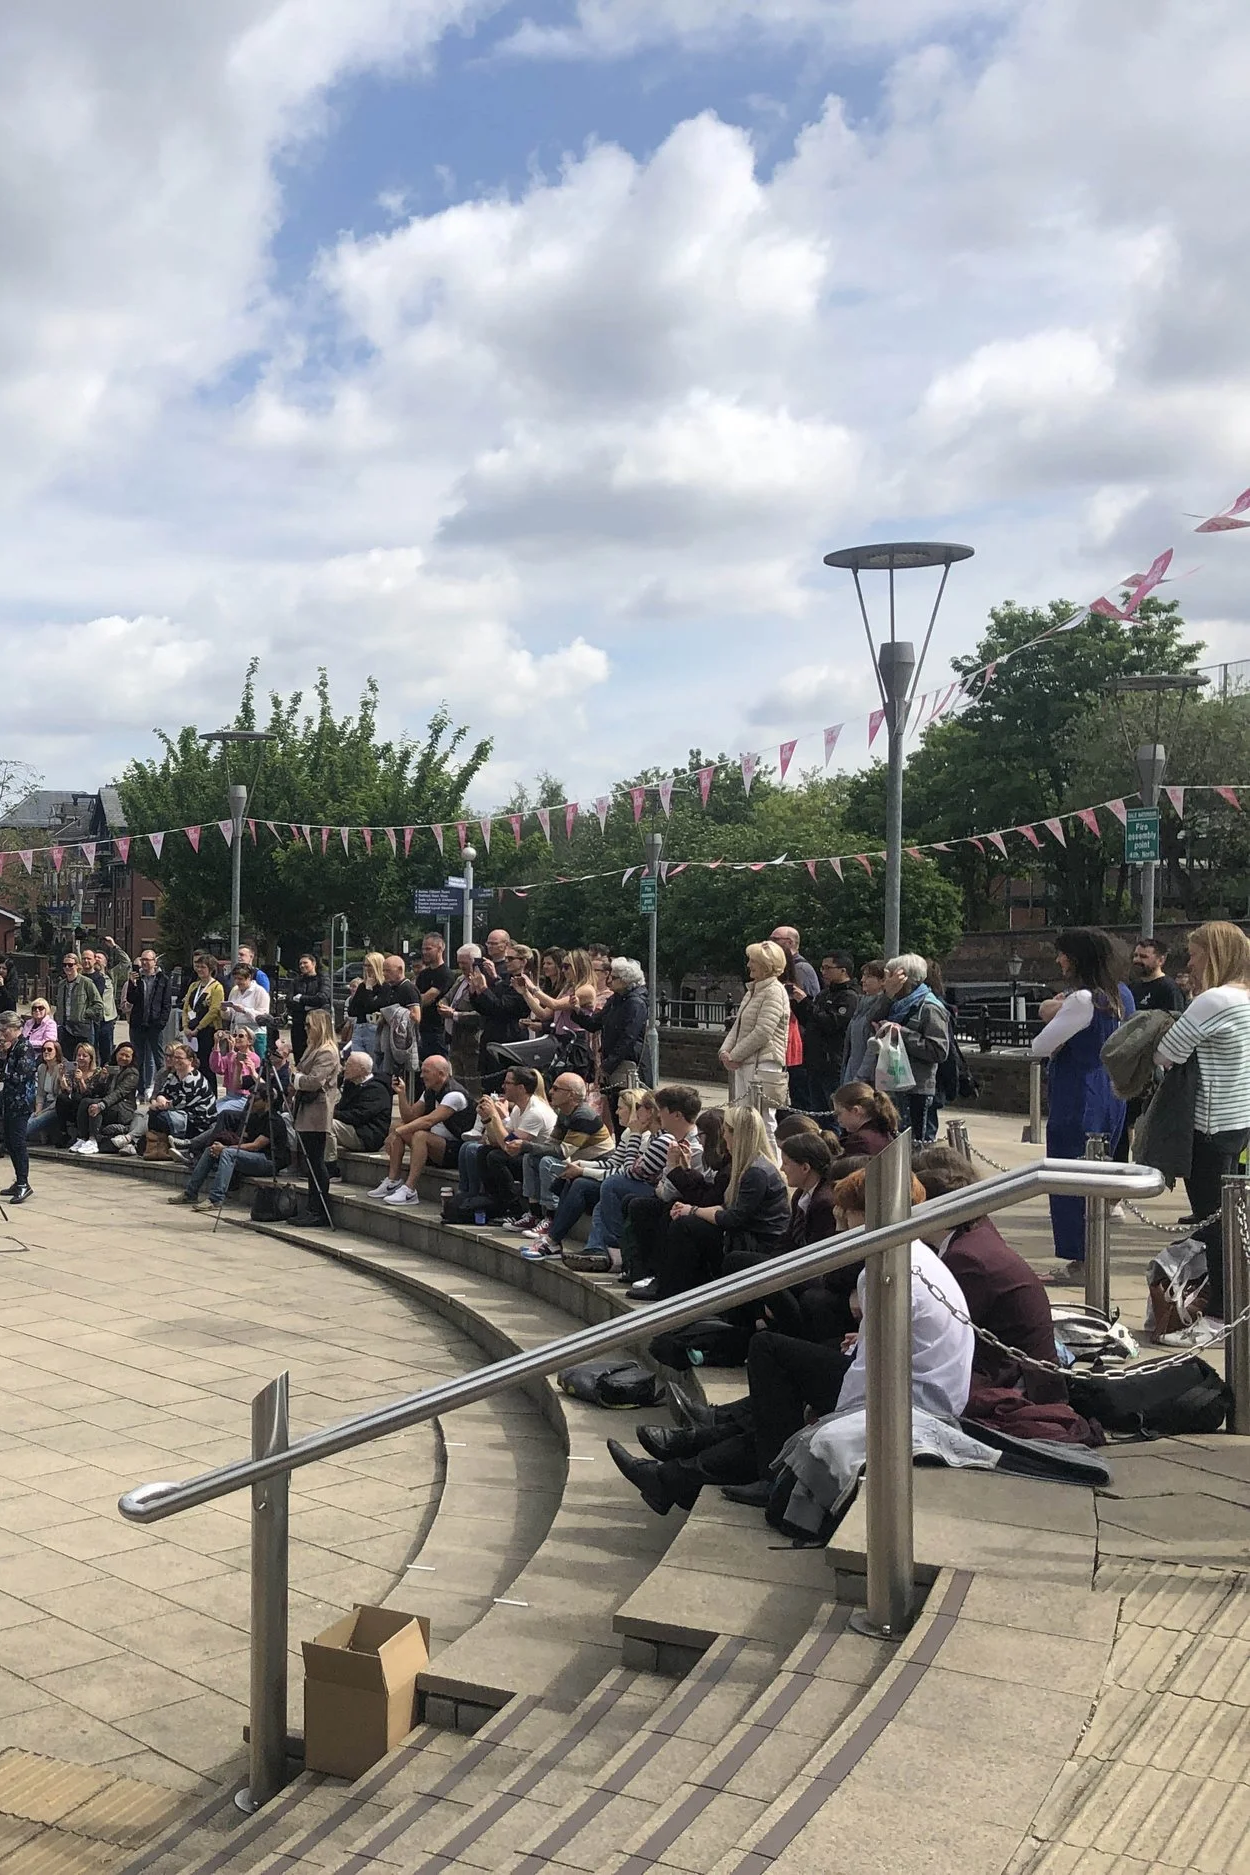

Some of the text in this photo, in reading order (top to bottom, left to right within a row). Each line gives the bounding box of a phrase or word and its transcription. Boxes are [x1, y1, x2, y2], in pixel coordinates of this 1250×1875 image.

[1135, 823, 1149, 831] Fire
[1128, 831, 1156, 840] assembly
[1134, 840, 1150, 850] point
